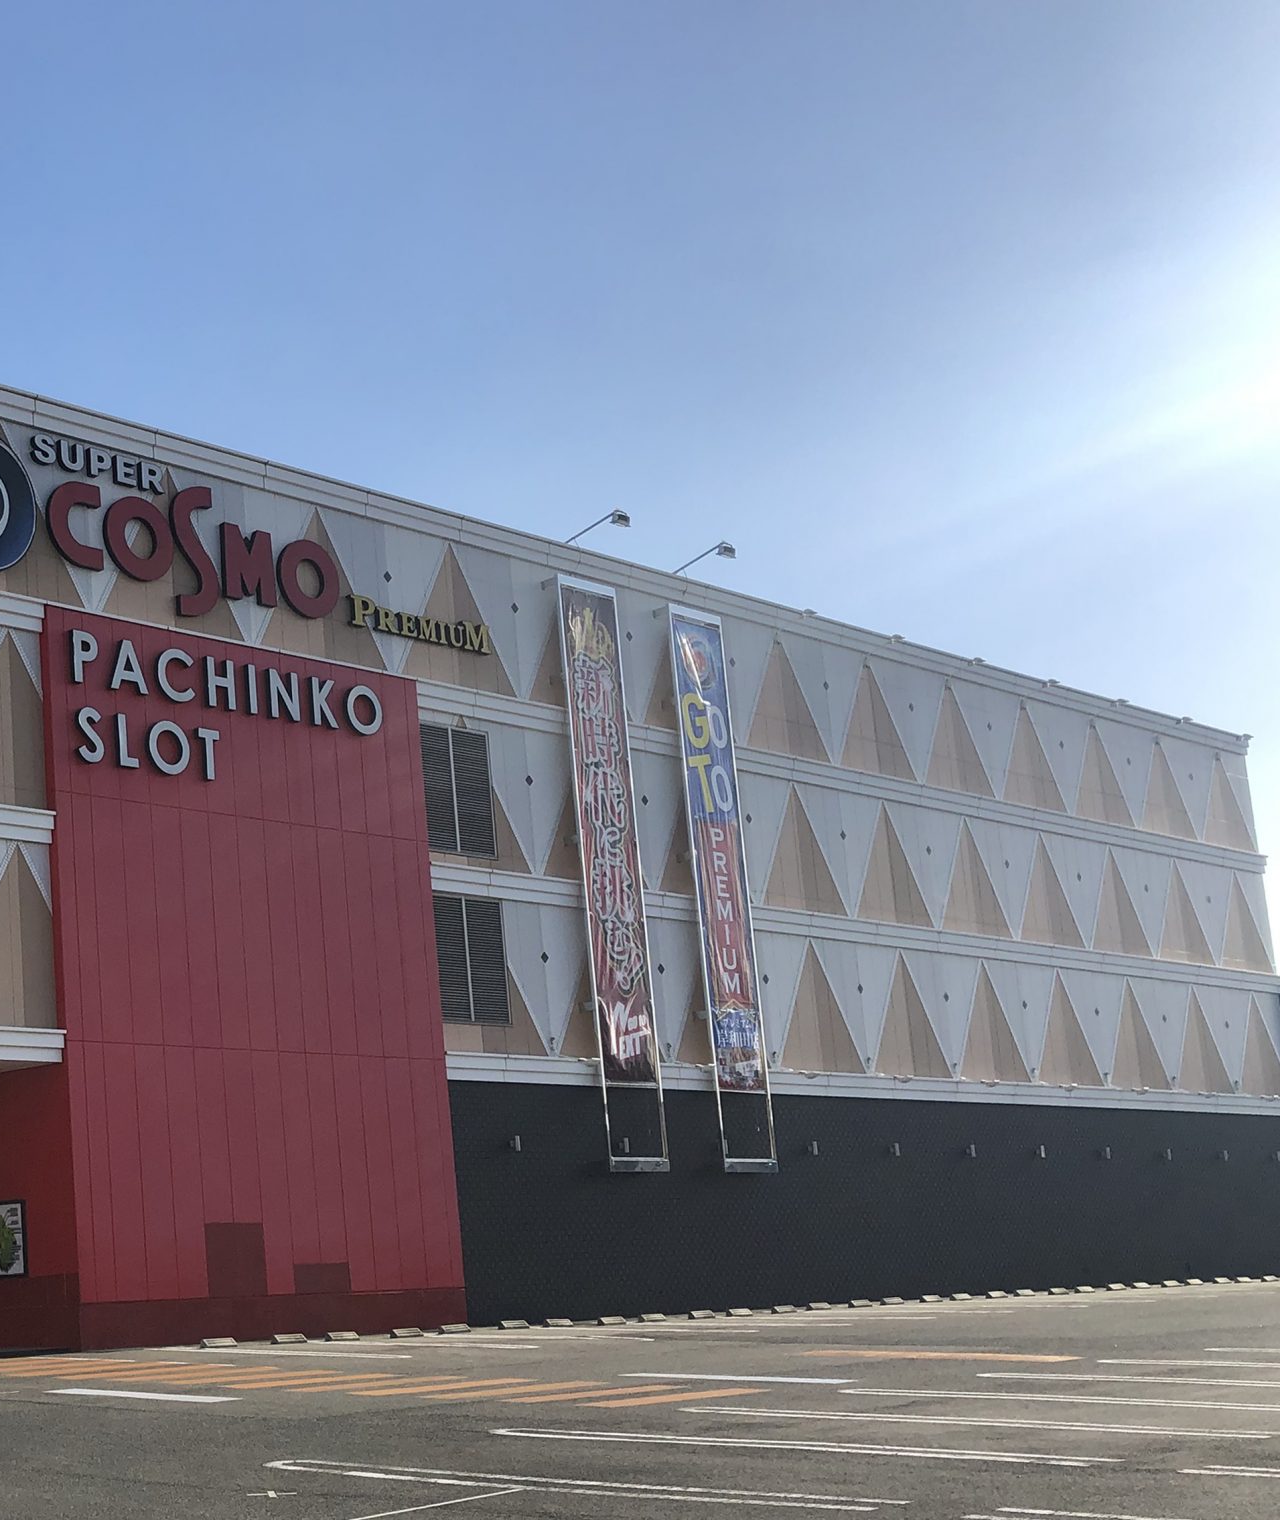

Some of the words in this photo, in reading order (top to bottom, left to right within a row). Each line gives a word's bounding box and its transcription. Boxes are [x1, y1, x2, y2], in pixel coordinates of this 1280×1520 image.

[31, 433, 165, 495] SUPER
[47, 485, 341, 619] COSMO
[348, 594, 493, 655] PREMIUM
[71, 628, 384, 736] PACHINKO
[77, 706, 220, 781] SLOT
[680, 692, 728, 749] GO
[688, 754, 733, 814] TO
[709, 827, 741, 995] PREMIUM
